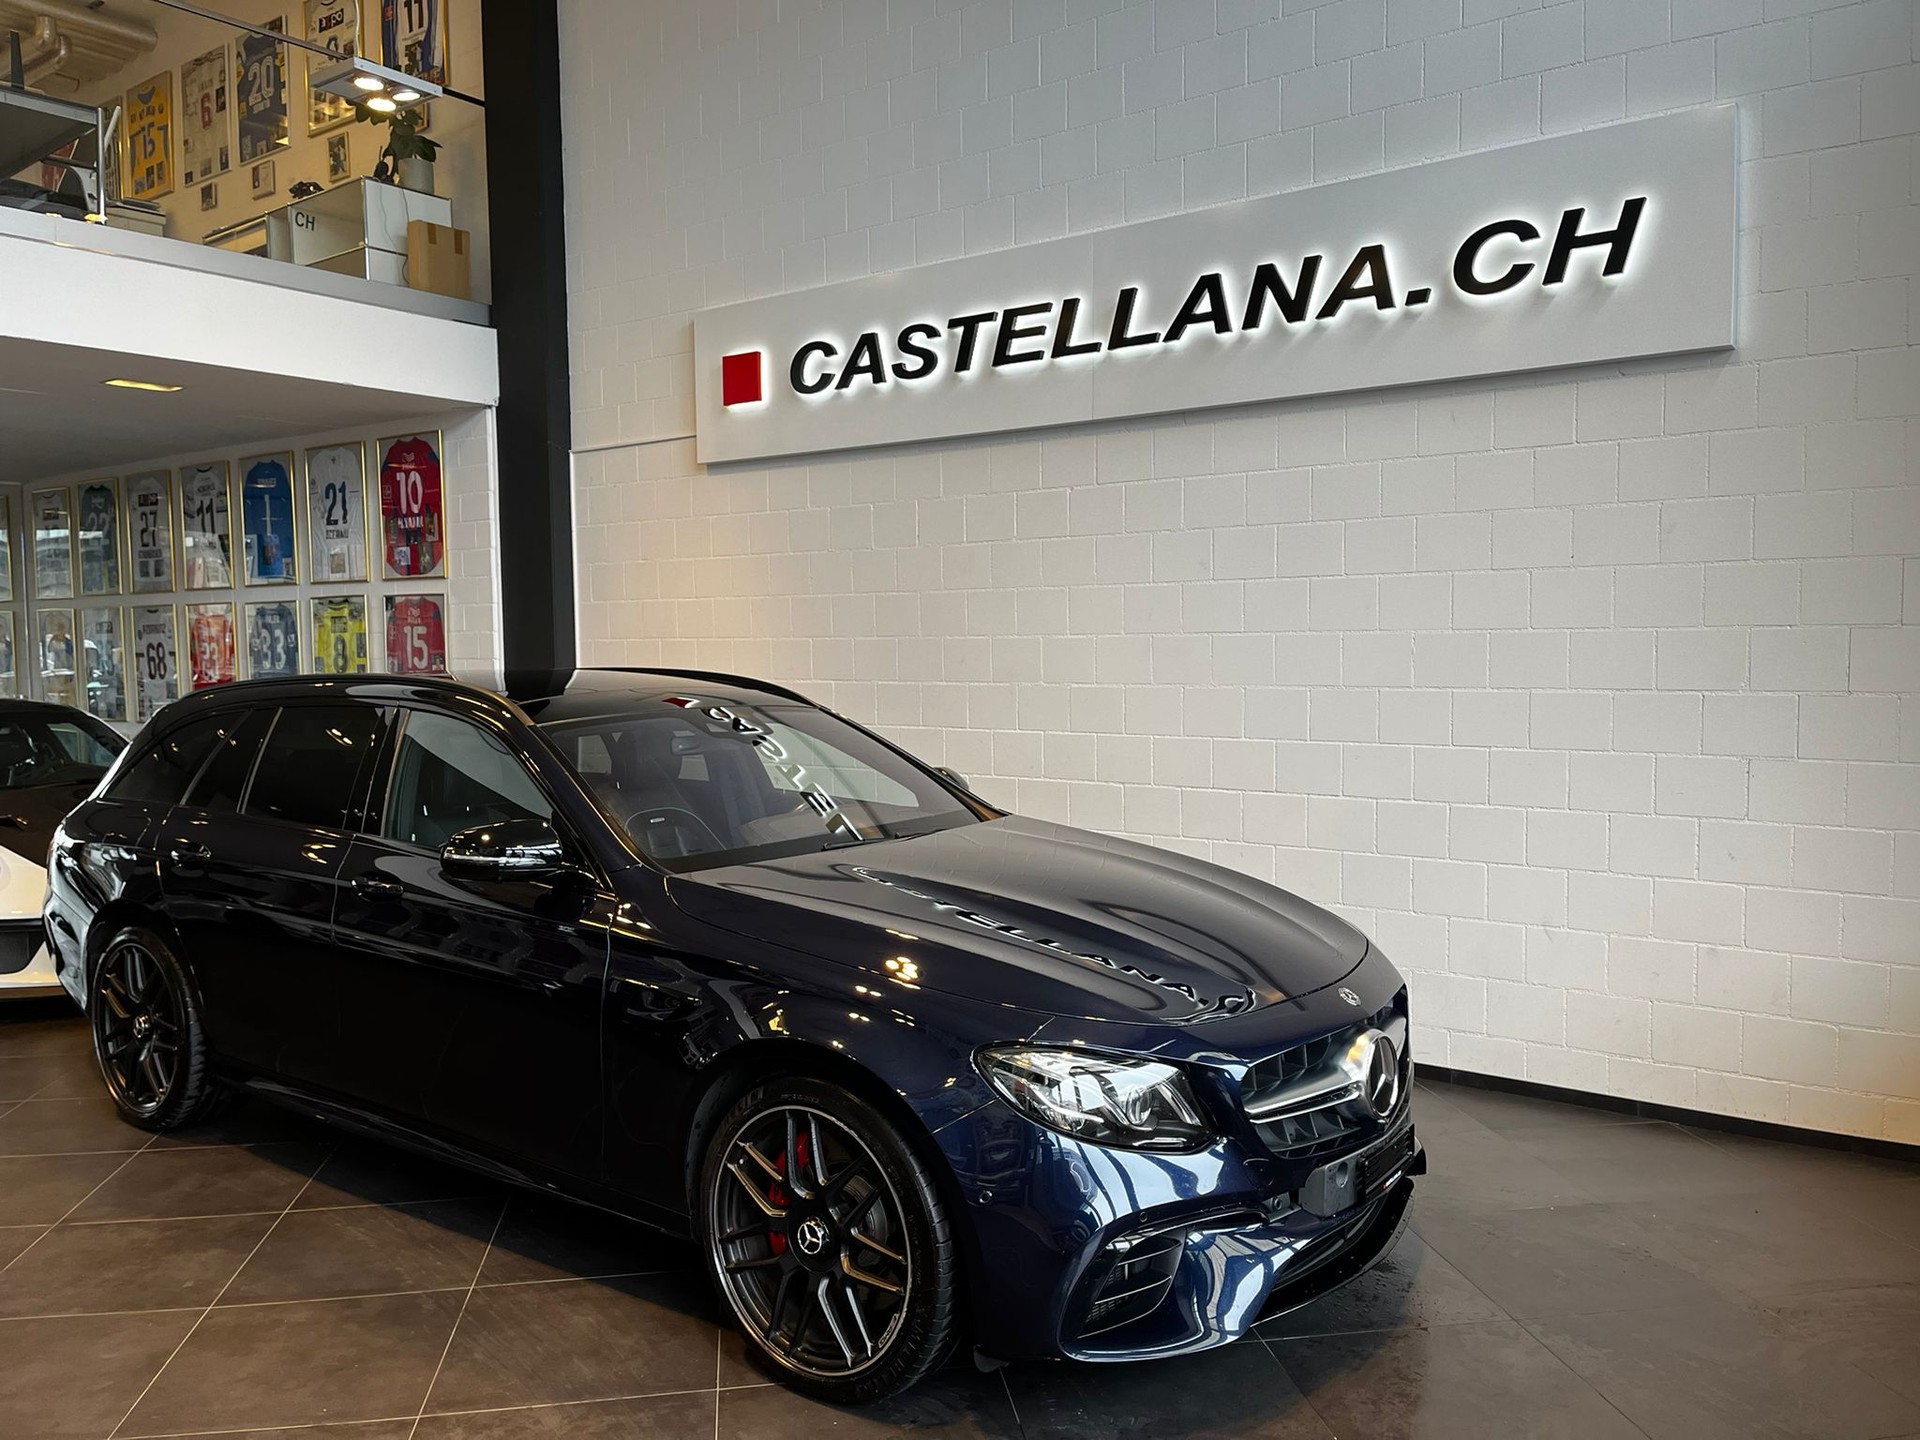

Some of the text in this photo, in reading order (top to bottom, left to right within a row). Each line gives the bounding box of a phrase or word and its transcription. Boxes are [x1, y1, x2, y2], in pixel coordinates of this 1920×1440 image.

[248, 55, 275, 107] 20
[295, 211, 315, 231] CH
[789, 196, 1648, 394] CASTELLANA.CH
[325, 481, 348, 526] 21
[396, 470, 423, 514] 10
[140, 510, 157, 548] 27
[196, 498, 216, 535] 11
[146, 642, 167, 680] 68
[261, 628, 287, 671] 33
[404, 626, 428, 669] 15
